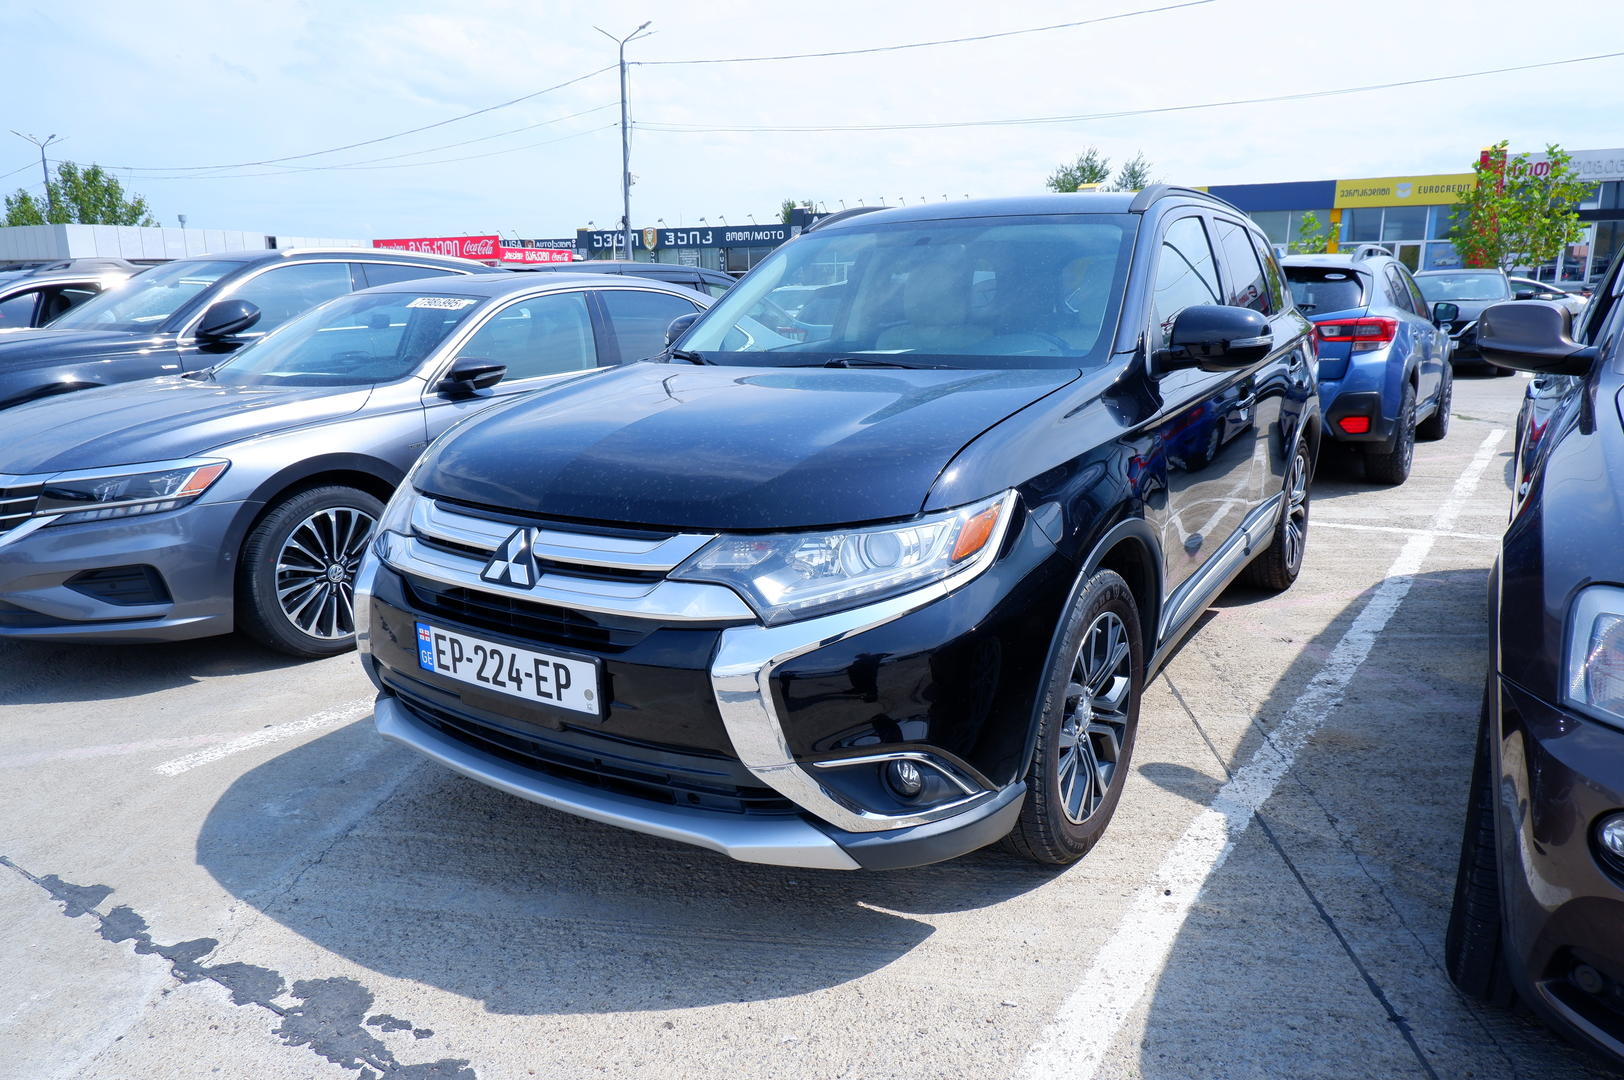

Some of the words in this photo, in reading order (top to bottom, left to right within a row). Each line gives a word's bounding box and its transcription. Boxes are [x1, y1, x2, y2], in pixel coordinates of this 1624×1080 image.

[1417, 183, 1471, 194] EUROCREDIT
[421, 649, 433, 665] GE
[434, 633, 572, 701] EP-224-EP
